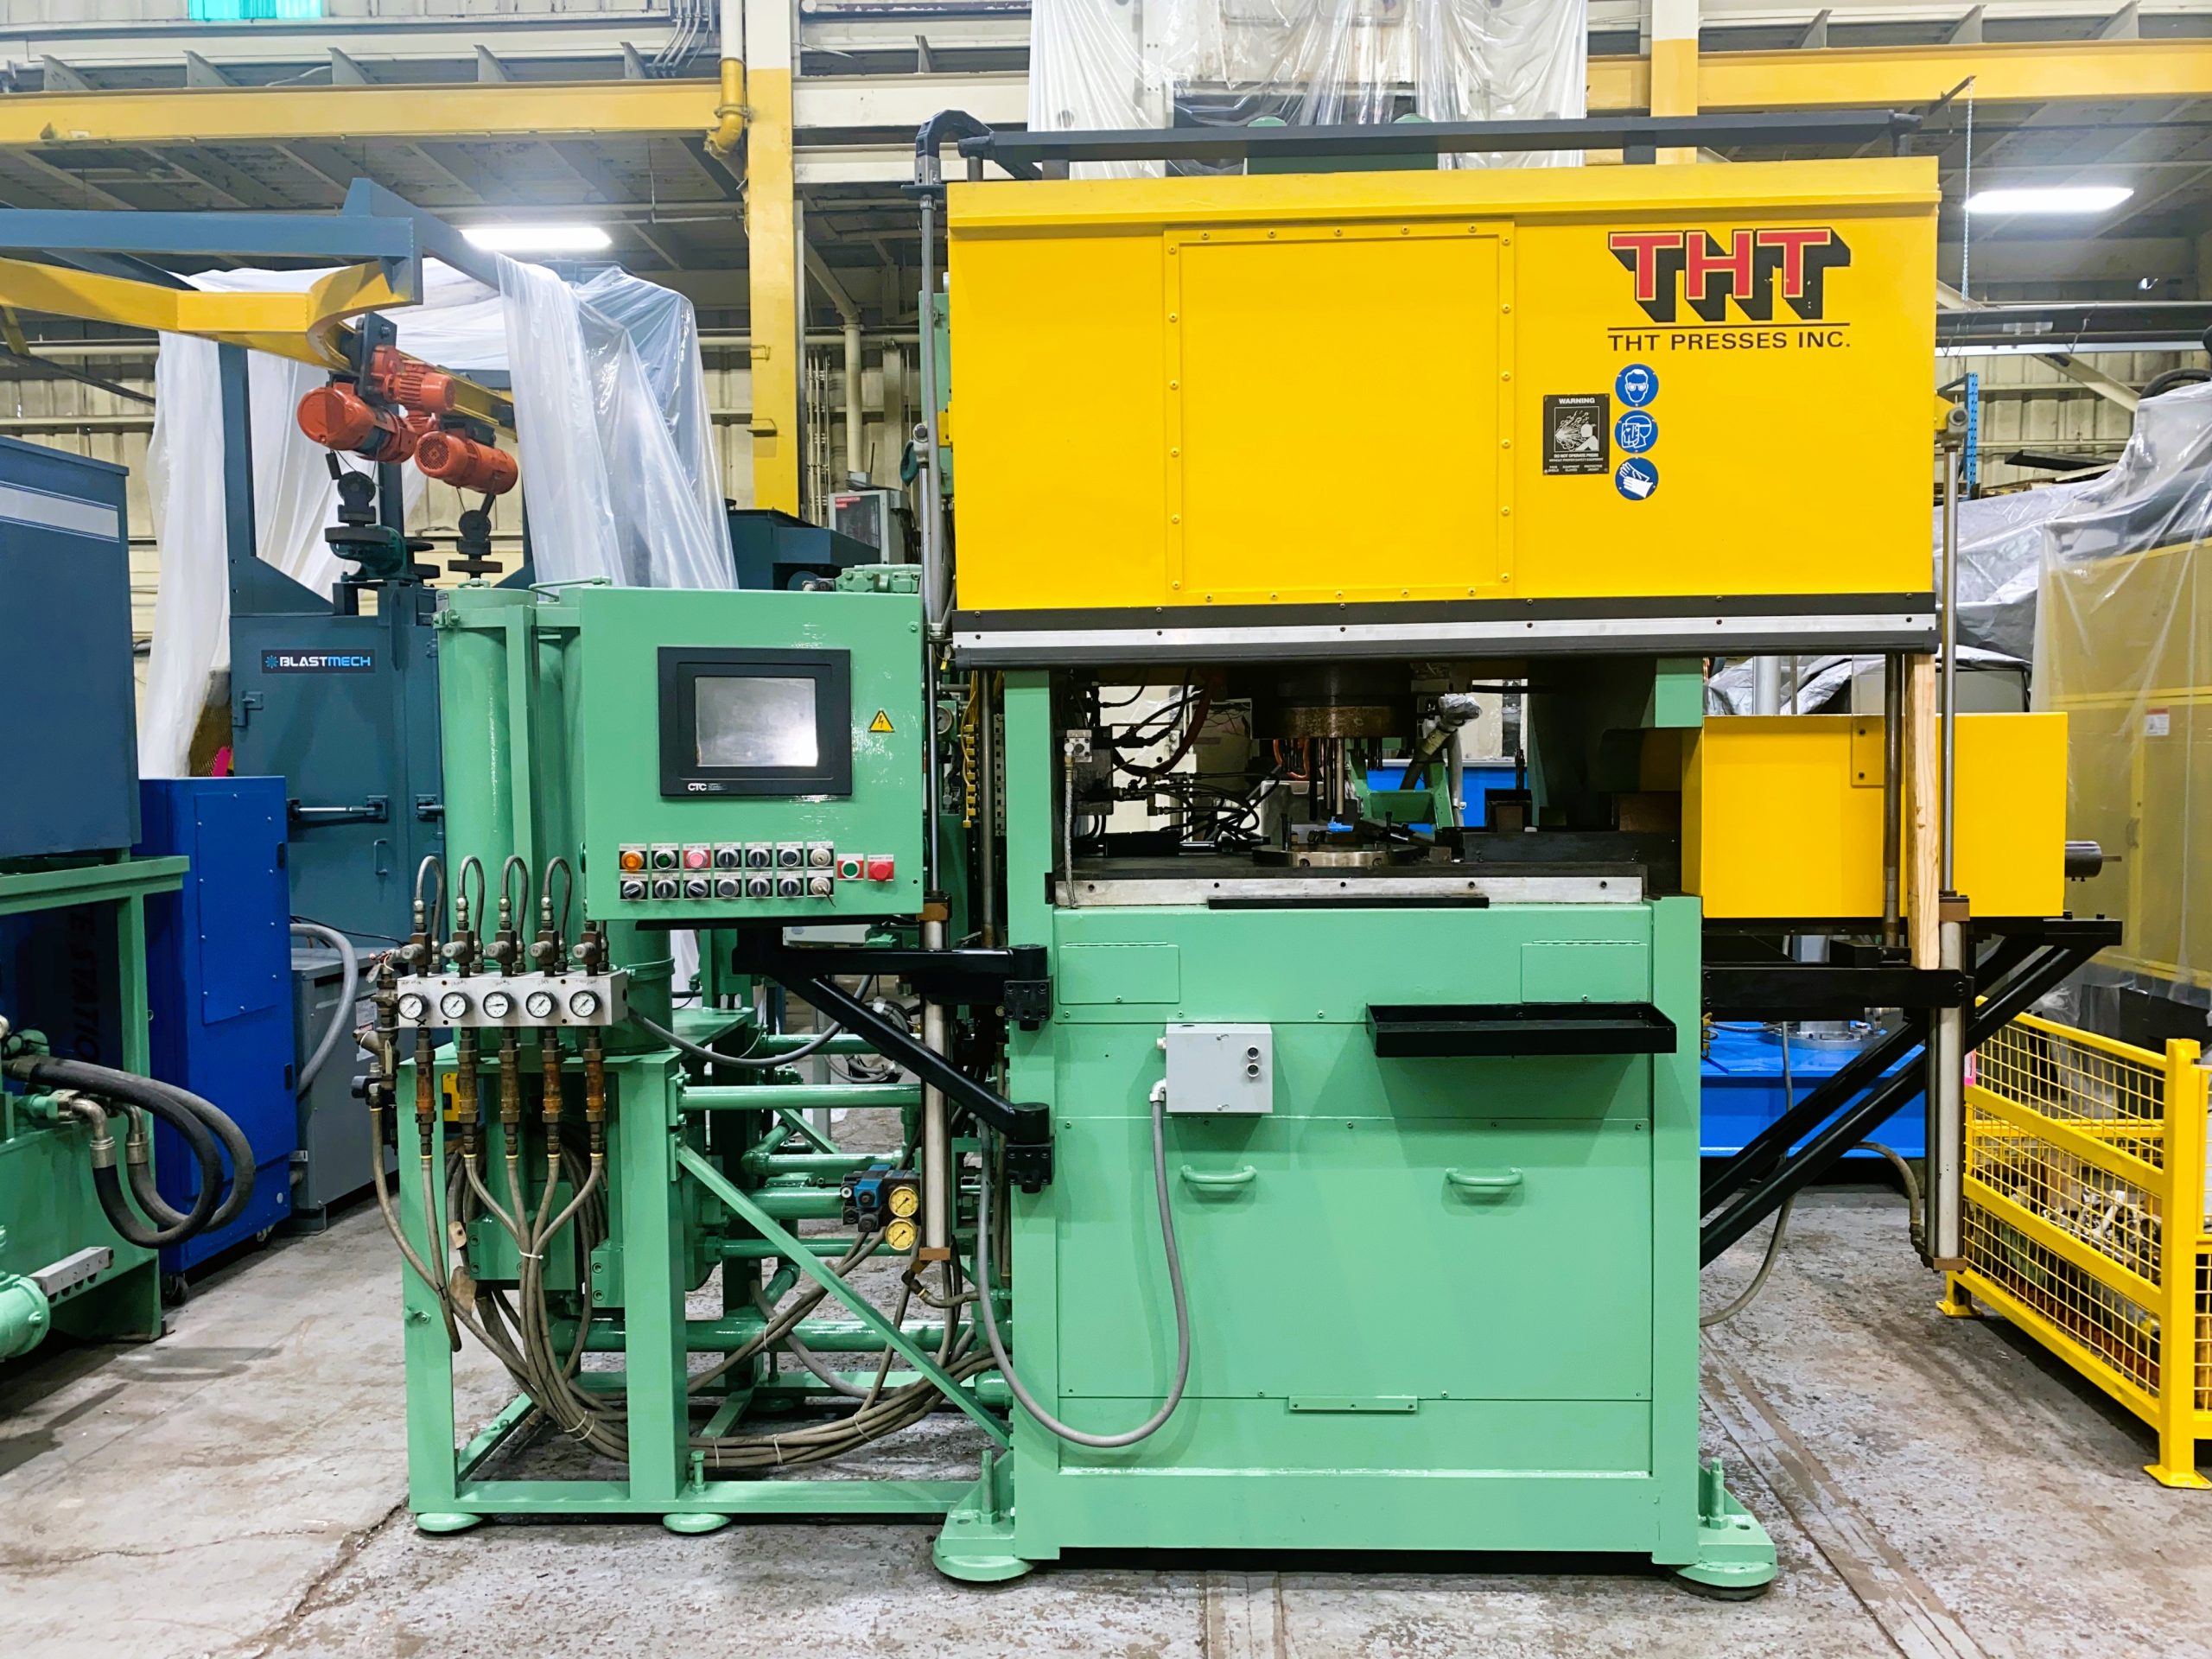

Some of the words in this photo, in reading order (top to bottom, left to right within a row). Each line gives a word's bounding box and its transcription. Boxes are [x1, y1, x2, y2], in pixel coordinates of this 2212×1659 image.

[1608, 226, 1851, 323] THT
[1607, 334, 1661, 352] THT
[1670, 331, 1788, 351] PRESSES
[1798, 330, 1851, 349] INC.
[279, 656, 371, 667] BLASTMECH
[687, 782, 708, 791] CTC
[70, 947, 100, 1063] STATIO
